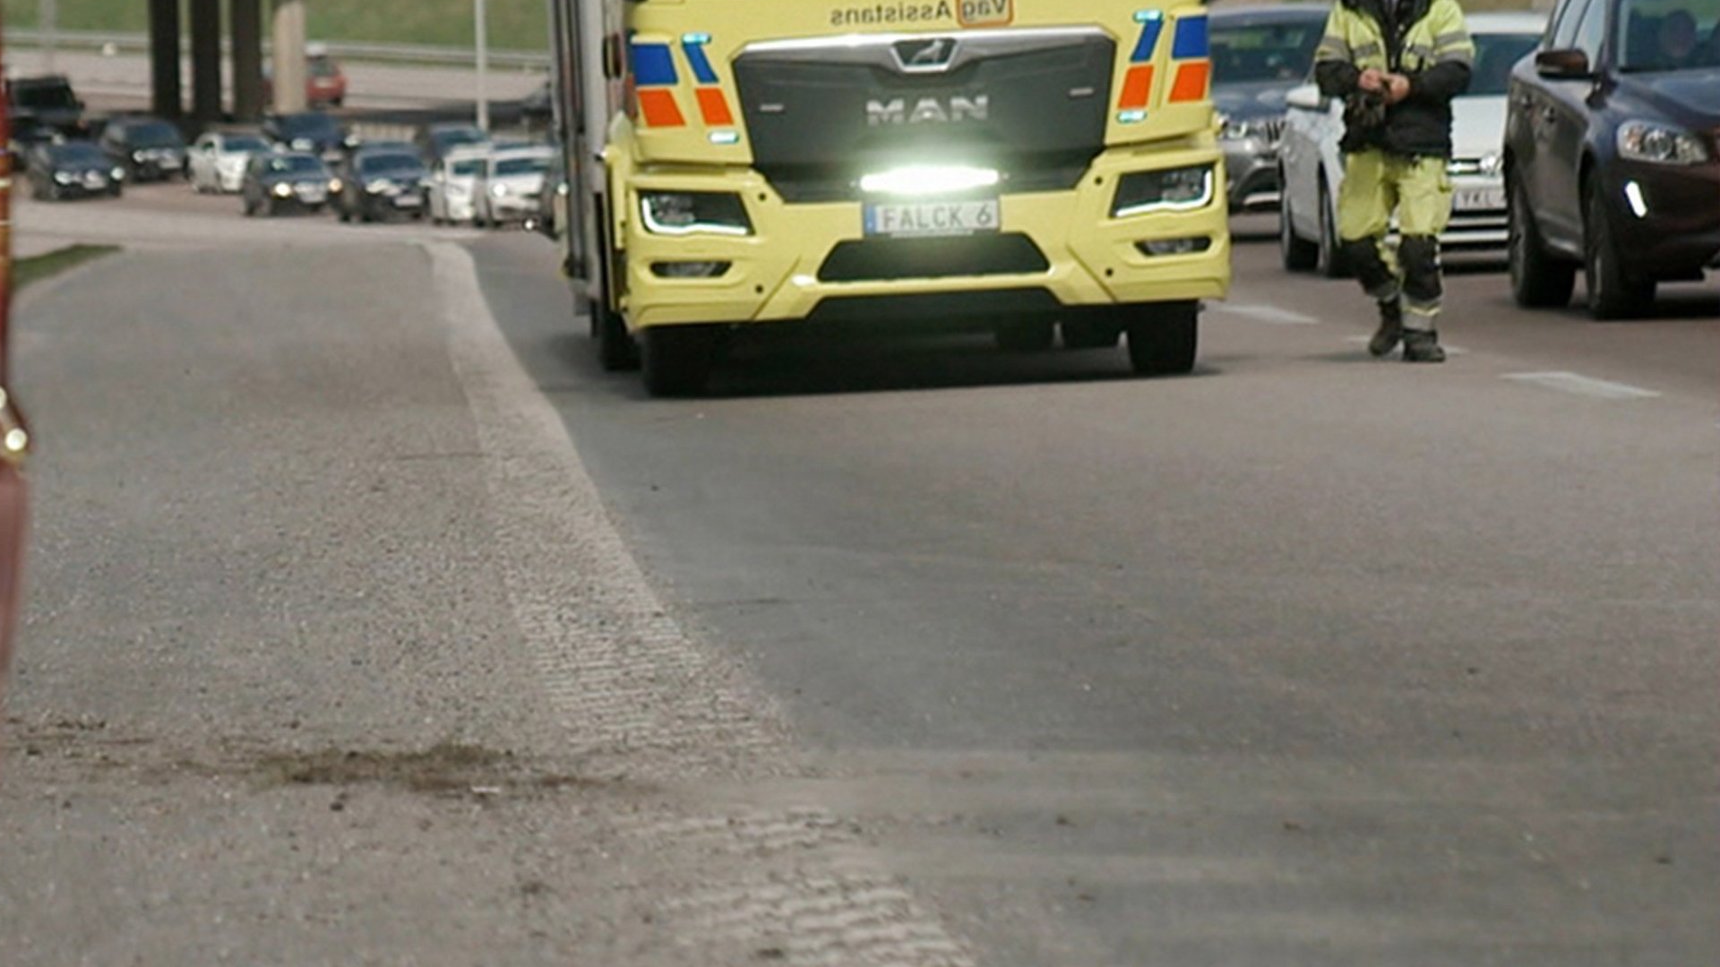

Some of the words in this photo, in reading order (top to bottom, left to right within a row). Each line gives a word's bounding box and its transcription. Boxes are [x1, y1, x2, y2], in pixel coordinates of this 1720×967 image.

[866, 95, 989, 126] MAN
[883, 206, 963, 229] FALCK
[977, 204, 992, 225] 6
